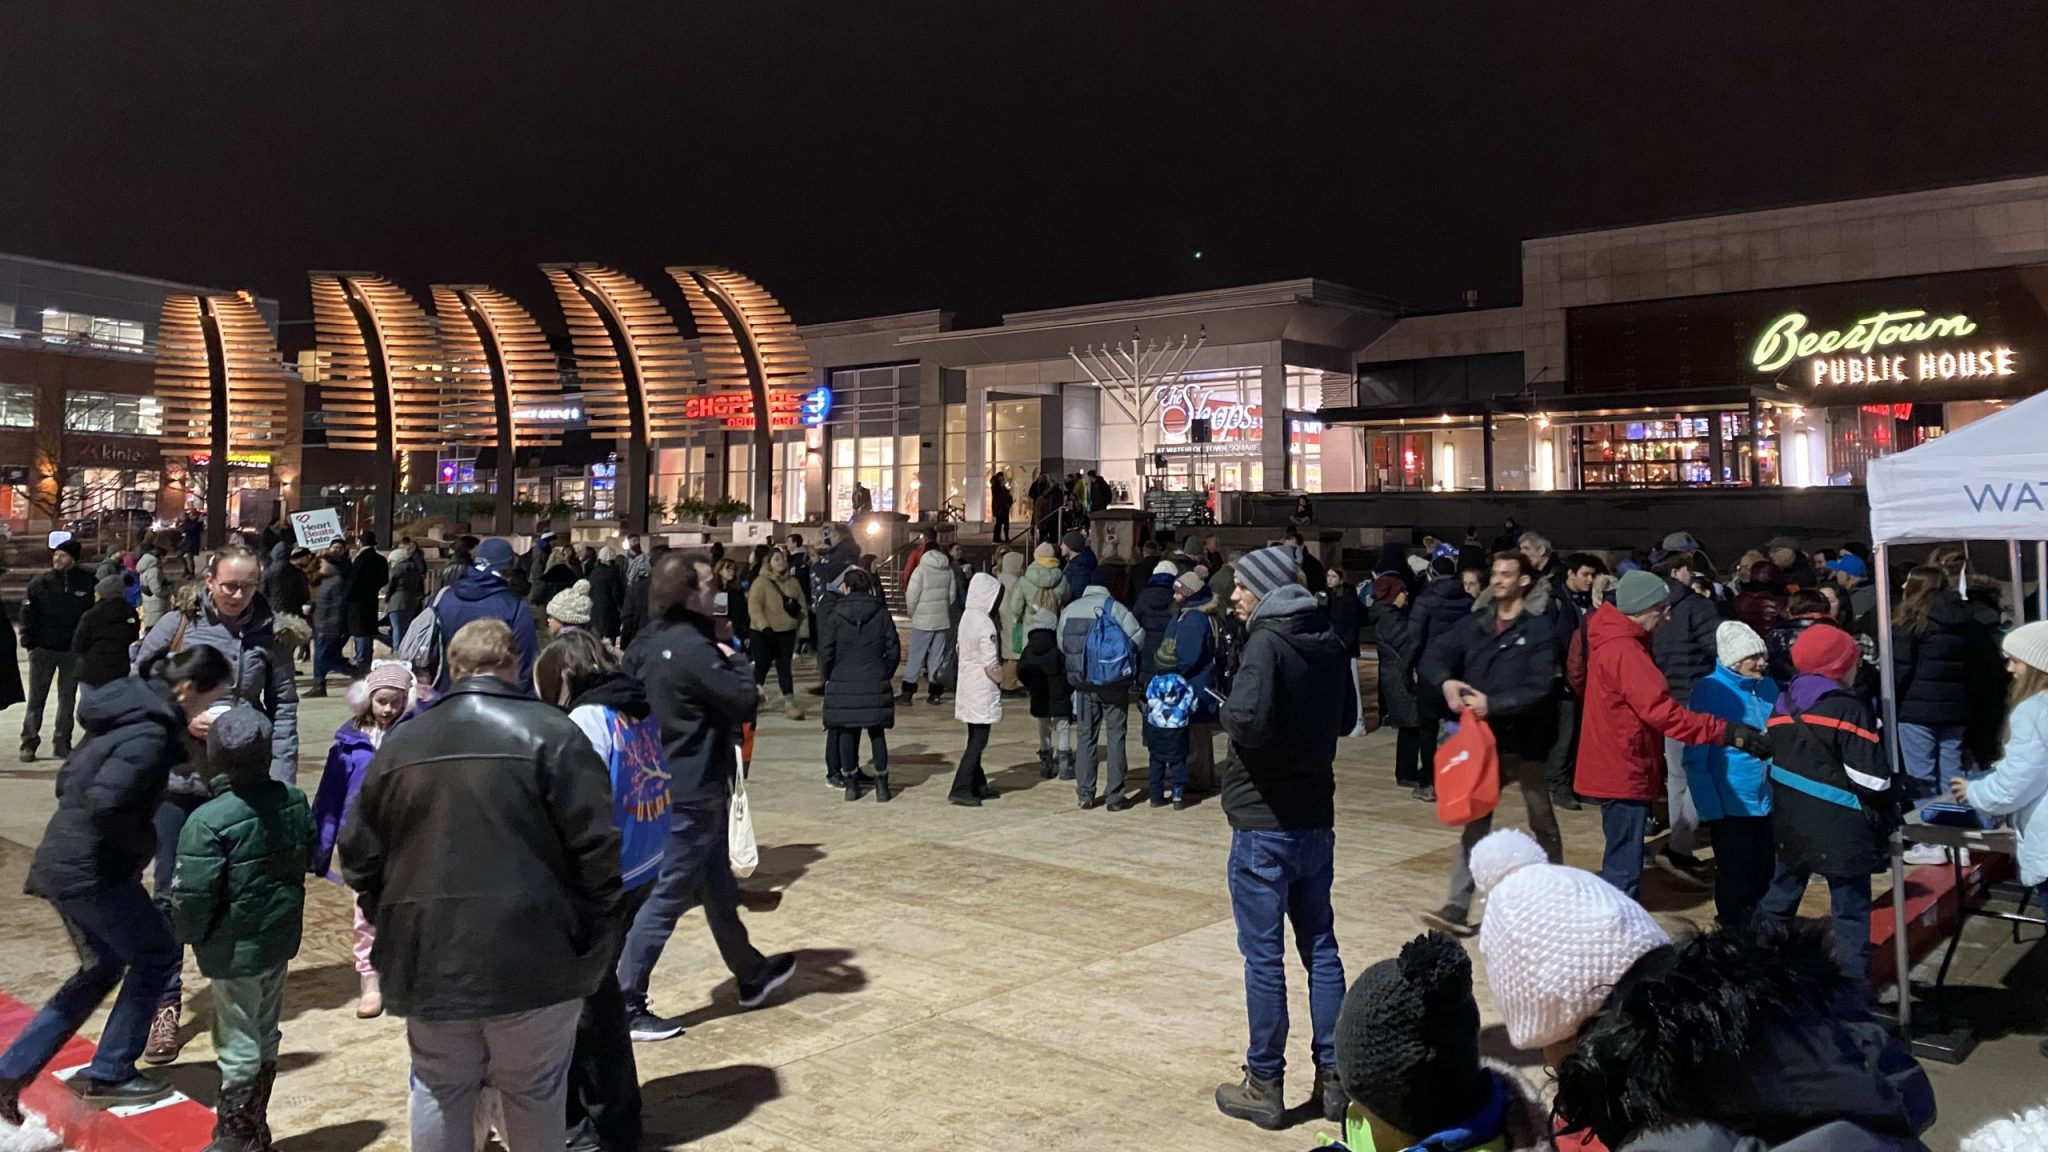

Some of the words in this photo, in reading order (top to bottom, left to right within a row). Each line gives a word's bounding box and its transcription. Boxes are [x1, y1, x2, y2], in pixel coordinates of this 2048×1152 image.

[1753, 310, 1977, 372] Beertown
[1812, 354, 1908, 386] PUBLIC
[1919, 347, 2014, 381] HOUSE
[686, 391, 801, 418] SHOPPRS
[1154, 384, 1183, 407] The
[1161, 383, 1257, 440] Shops
[1205, 444, 1228, 452] TOWN
[1228, 443, 1258, 452] SQUARE
[302, 521, 331, 531] Heart
[304, 528, 335, 537] Beats
[306, 536, 330, 545] Hate
